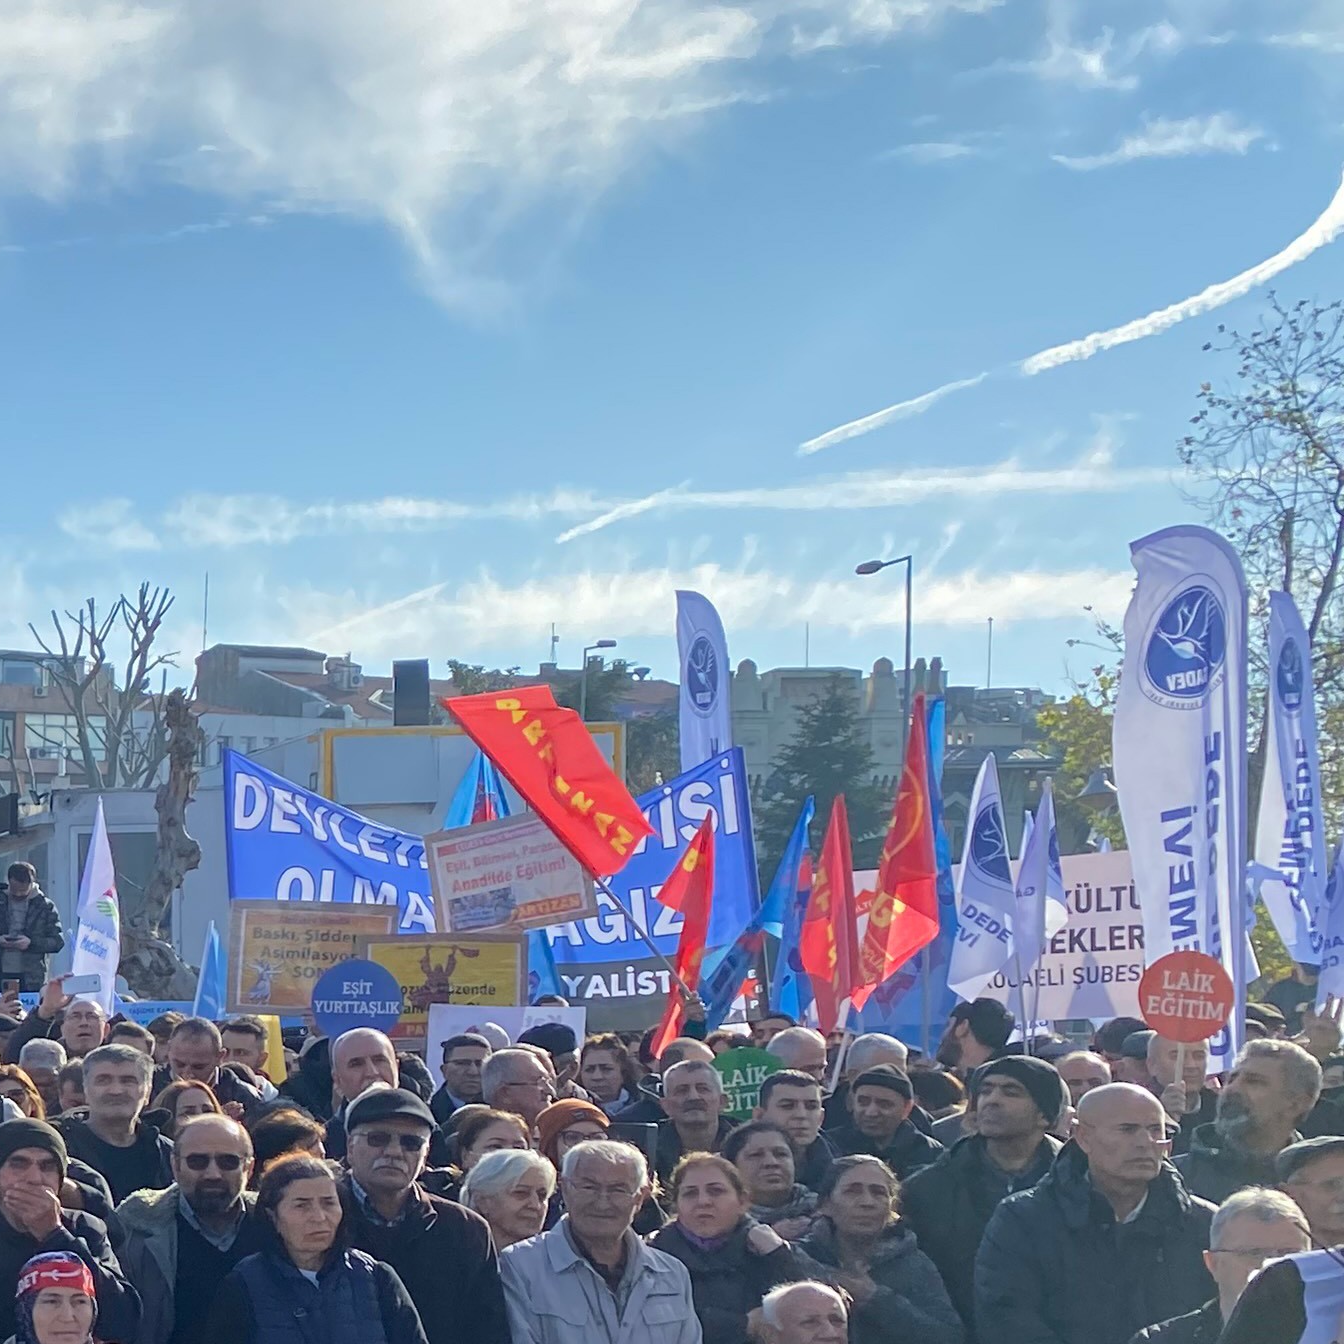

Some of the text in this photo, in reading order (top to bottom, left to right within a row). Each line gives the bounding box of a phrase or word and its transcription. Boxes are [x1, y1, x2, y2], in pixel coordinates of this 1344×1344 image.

[962, 903, 1014, 944] DEDE
[341, 978, 373, 1000] EŞİT
[1162, 965, 1216, 994] LAİK
[314, 999, 401, 1018] YURTTAŞLIK
[1146, 990, 1226, 1021] EĞİTİM
